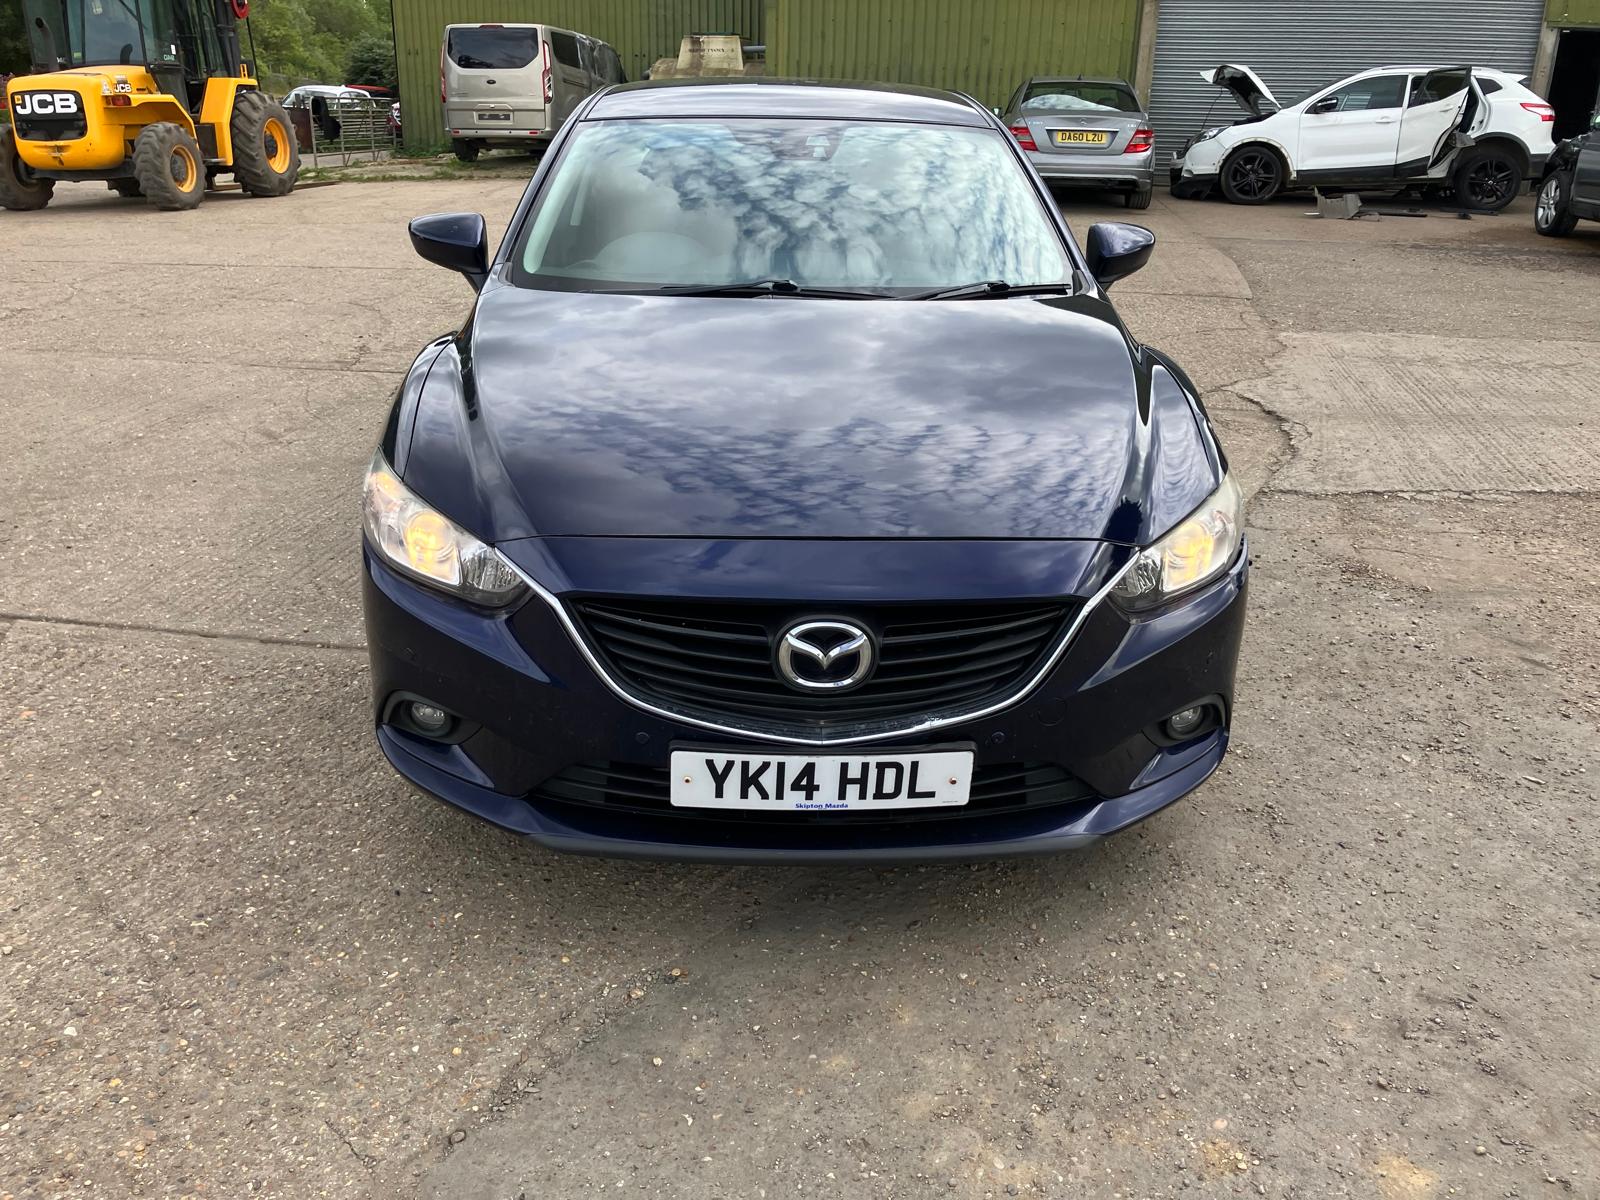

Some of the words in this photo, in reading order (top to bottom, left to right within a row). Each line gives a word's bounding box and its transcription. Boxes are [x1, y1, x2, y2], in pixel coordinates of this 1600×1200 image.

[114, 83, 131, 93] JCB
[15, 93, 78, 115] JCB
[1061, 131, 1084, 142] DA60
[1085, 132, 1103, 142] LZU
[704, 758, 820, 801] YK14
[837, 760, 936, 801] HDL
